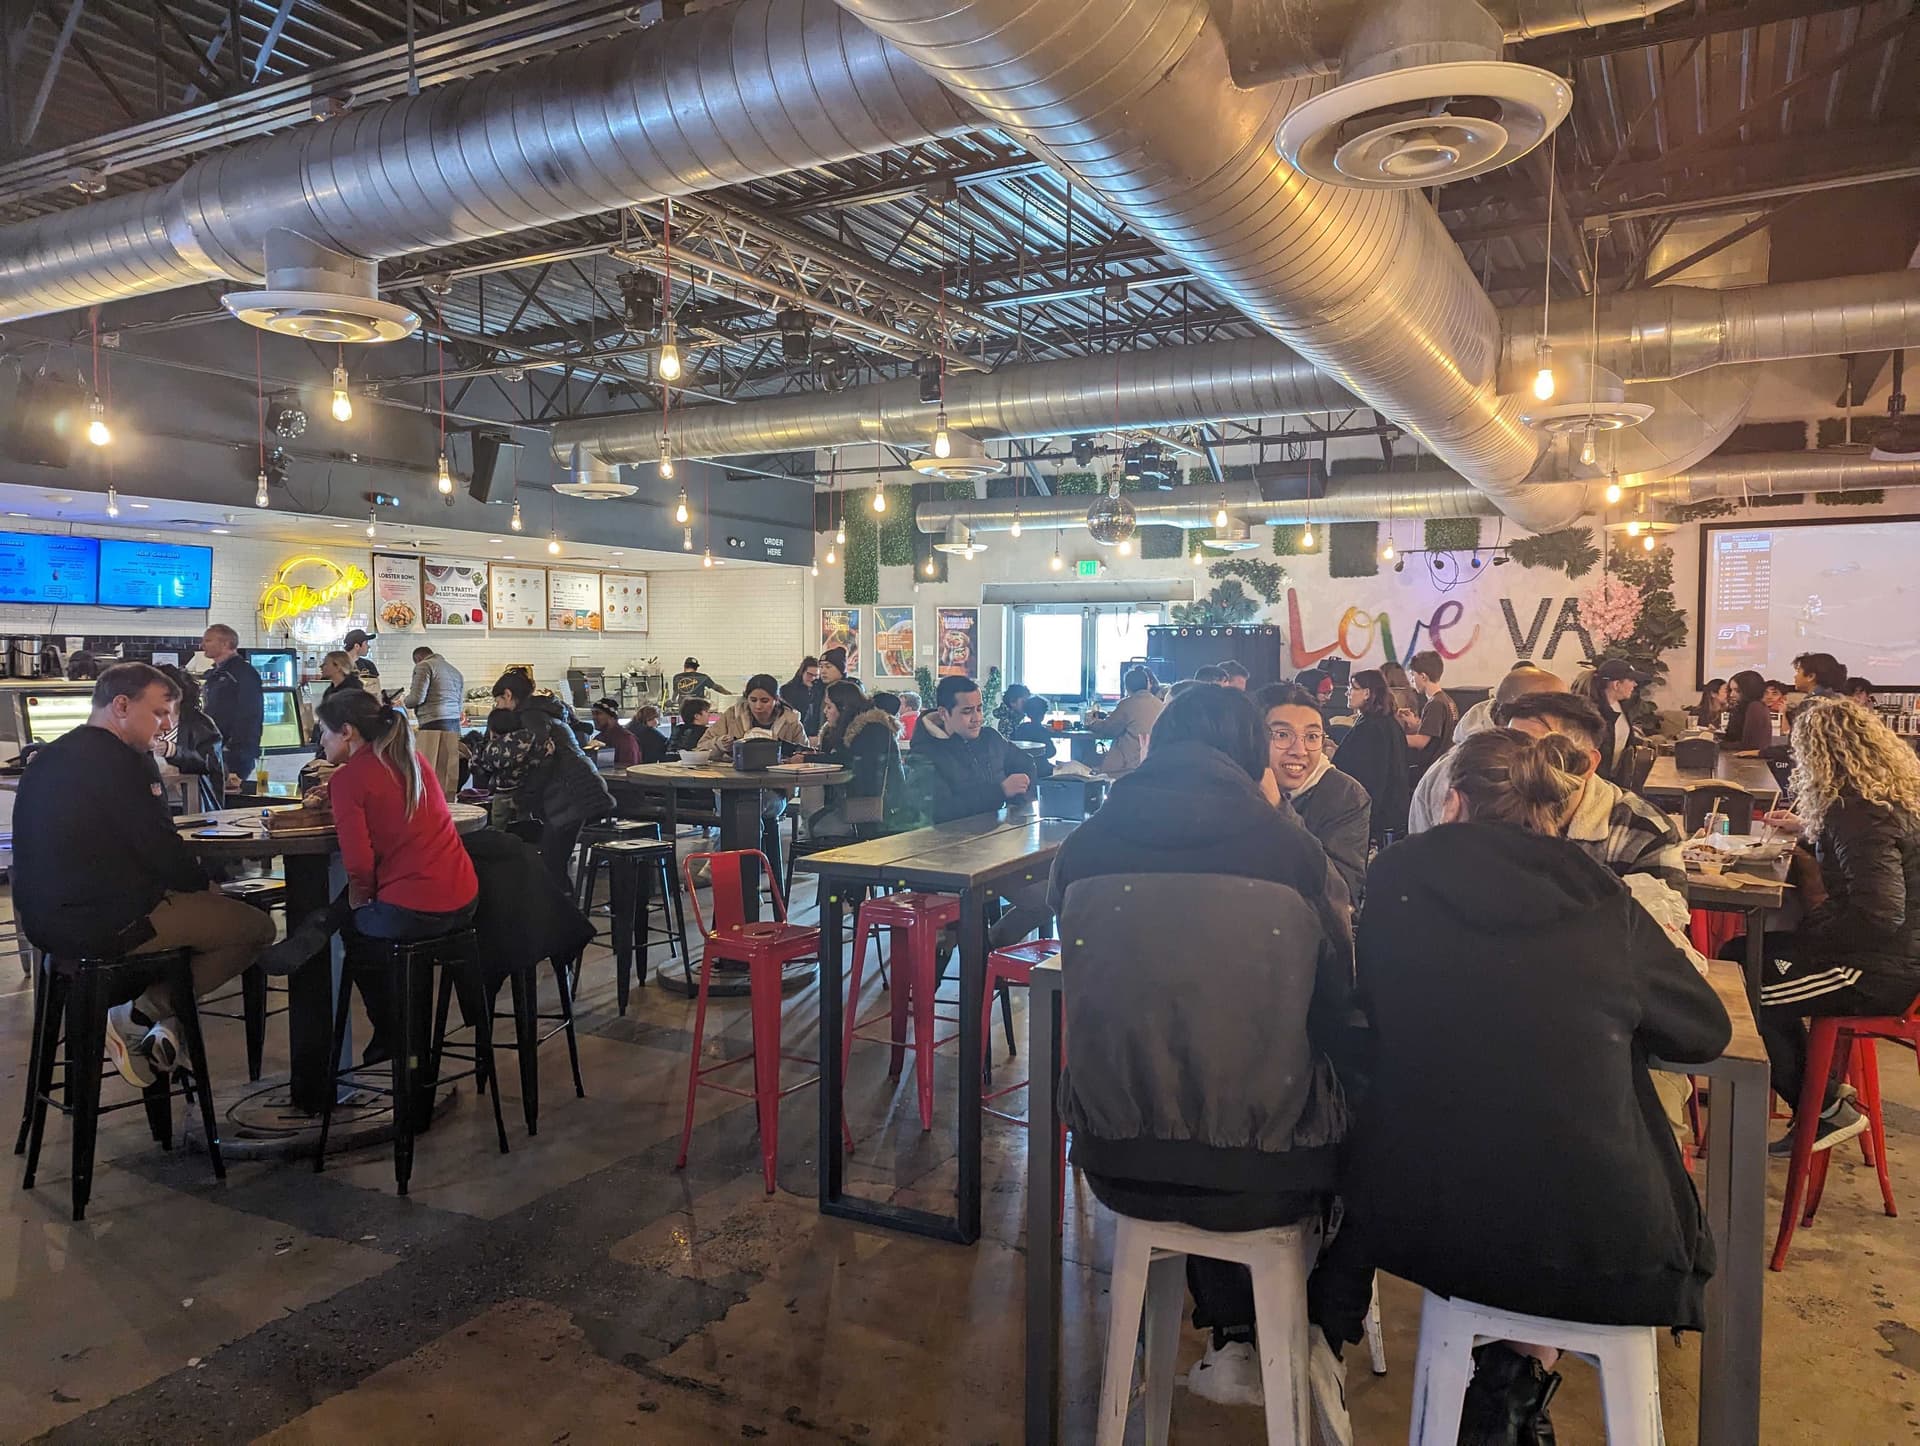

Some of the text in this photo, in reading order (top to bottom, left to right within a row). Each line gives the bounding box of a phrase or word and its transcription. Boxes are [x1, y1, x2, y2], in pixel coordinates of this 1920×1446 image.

[764, 537, 784, 546] ORDER
[767, 548, 782, 556] HERE
[1080, 562, 1096, 575] EXIT
[1287, 587, 1597, 669] Love VA
